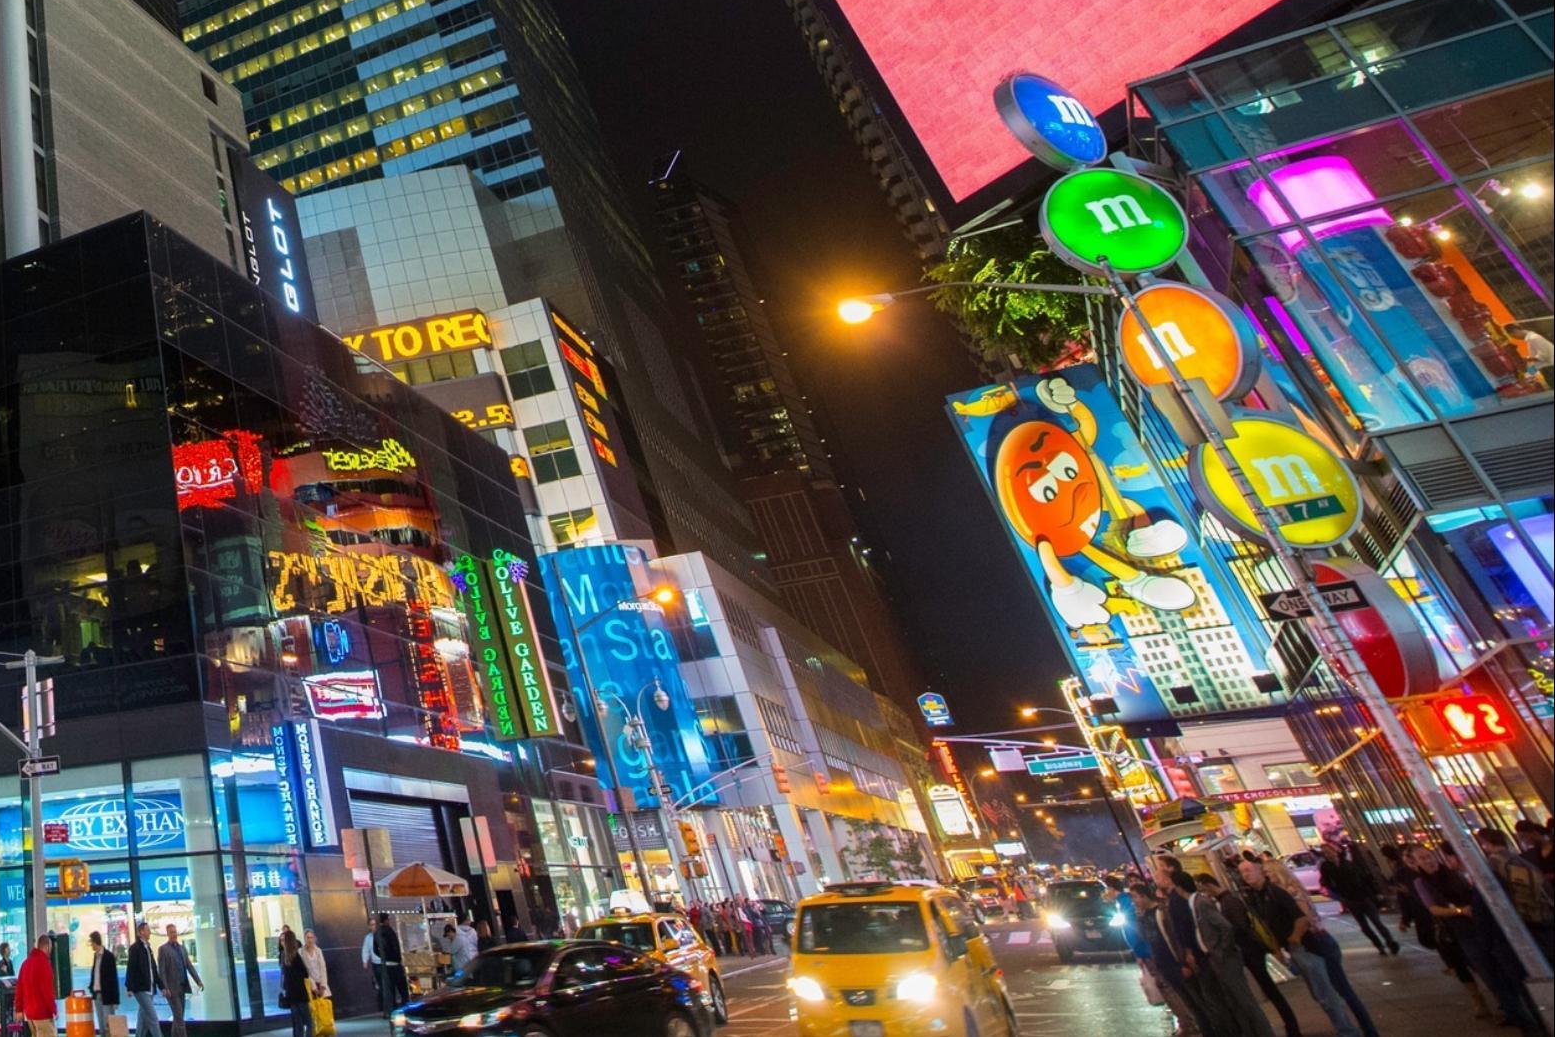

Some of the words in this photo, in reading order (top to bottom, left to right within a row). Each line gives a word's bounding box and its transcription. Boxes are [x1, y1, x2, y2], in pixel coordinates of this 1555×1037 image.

[371, 325, 423, 360] TO
[1294, 503, 1309, 519] 7
[1278, 595, 1309, 611] ONE
[495, 566, 524, 635] OLIVE
[514, 643, 548, 731] GARDEN
[295, 723, 312, 775] MONEY
[305, 777, 326, 843] CHANGE
[102, 810, 189, 836] EXCHAN
[155, 874, 235, 893] CHAE
